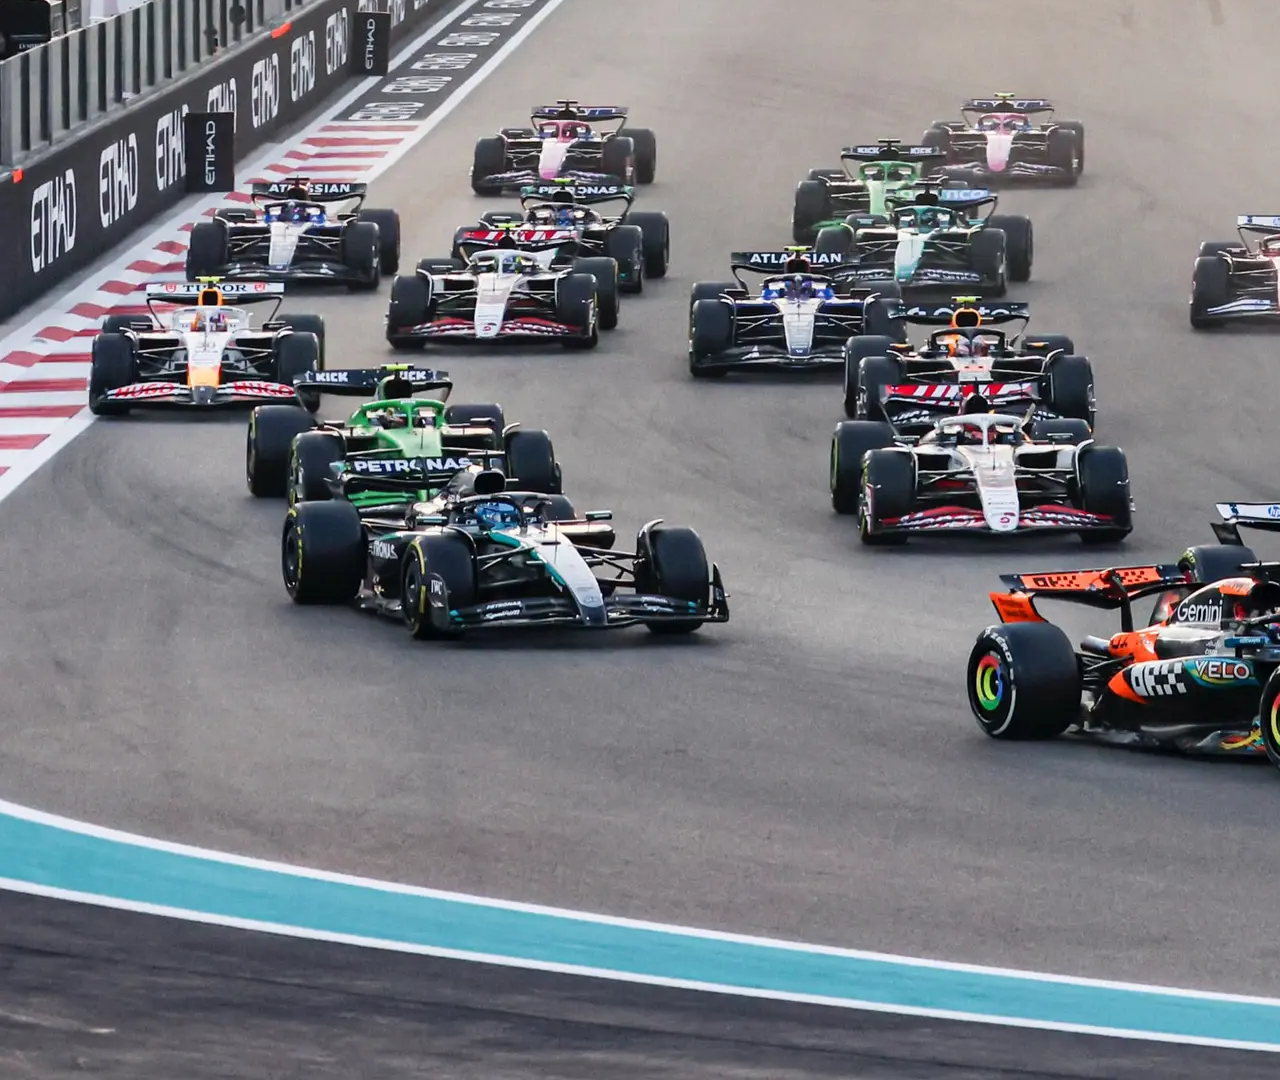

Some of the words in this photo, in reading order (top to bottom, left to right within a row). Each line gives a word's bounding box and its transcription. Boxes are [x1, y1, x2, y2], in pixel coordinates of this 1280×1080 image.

[365, 18, 376, 70] ETIHAD
[291, 30, 316, 102] ETIHAD
[252, 53, 279, 128] ETIHAD
[156, 104, 189, 191] ETIHA
[205, 120, 216, 186] ETIHAD
[100, 133, 138, 228] ETIHAD
[268, 184, 350, 193] ATSSIAN
[538, 186, 618, 194] PERONAS
[31, 169, 76, 273] ETIHAD
[750, 253, 842, 264] ATLASIAN
[233, 380, 296, 397] HUGO
[316, 372, 348, 382] KICK
[116, 382, 176, 398] HUGO
[1177, 600, 1223, 623] Gemini
[1196, 660, 1250, 680] VELO
